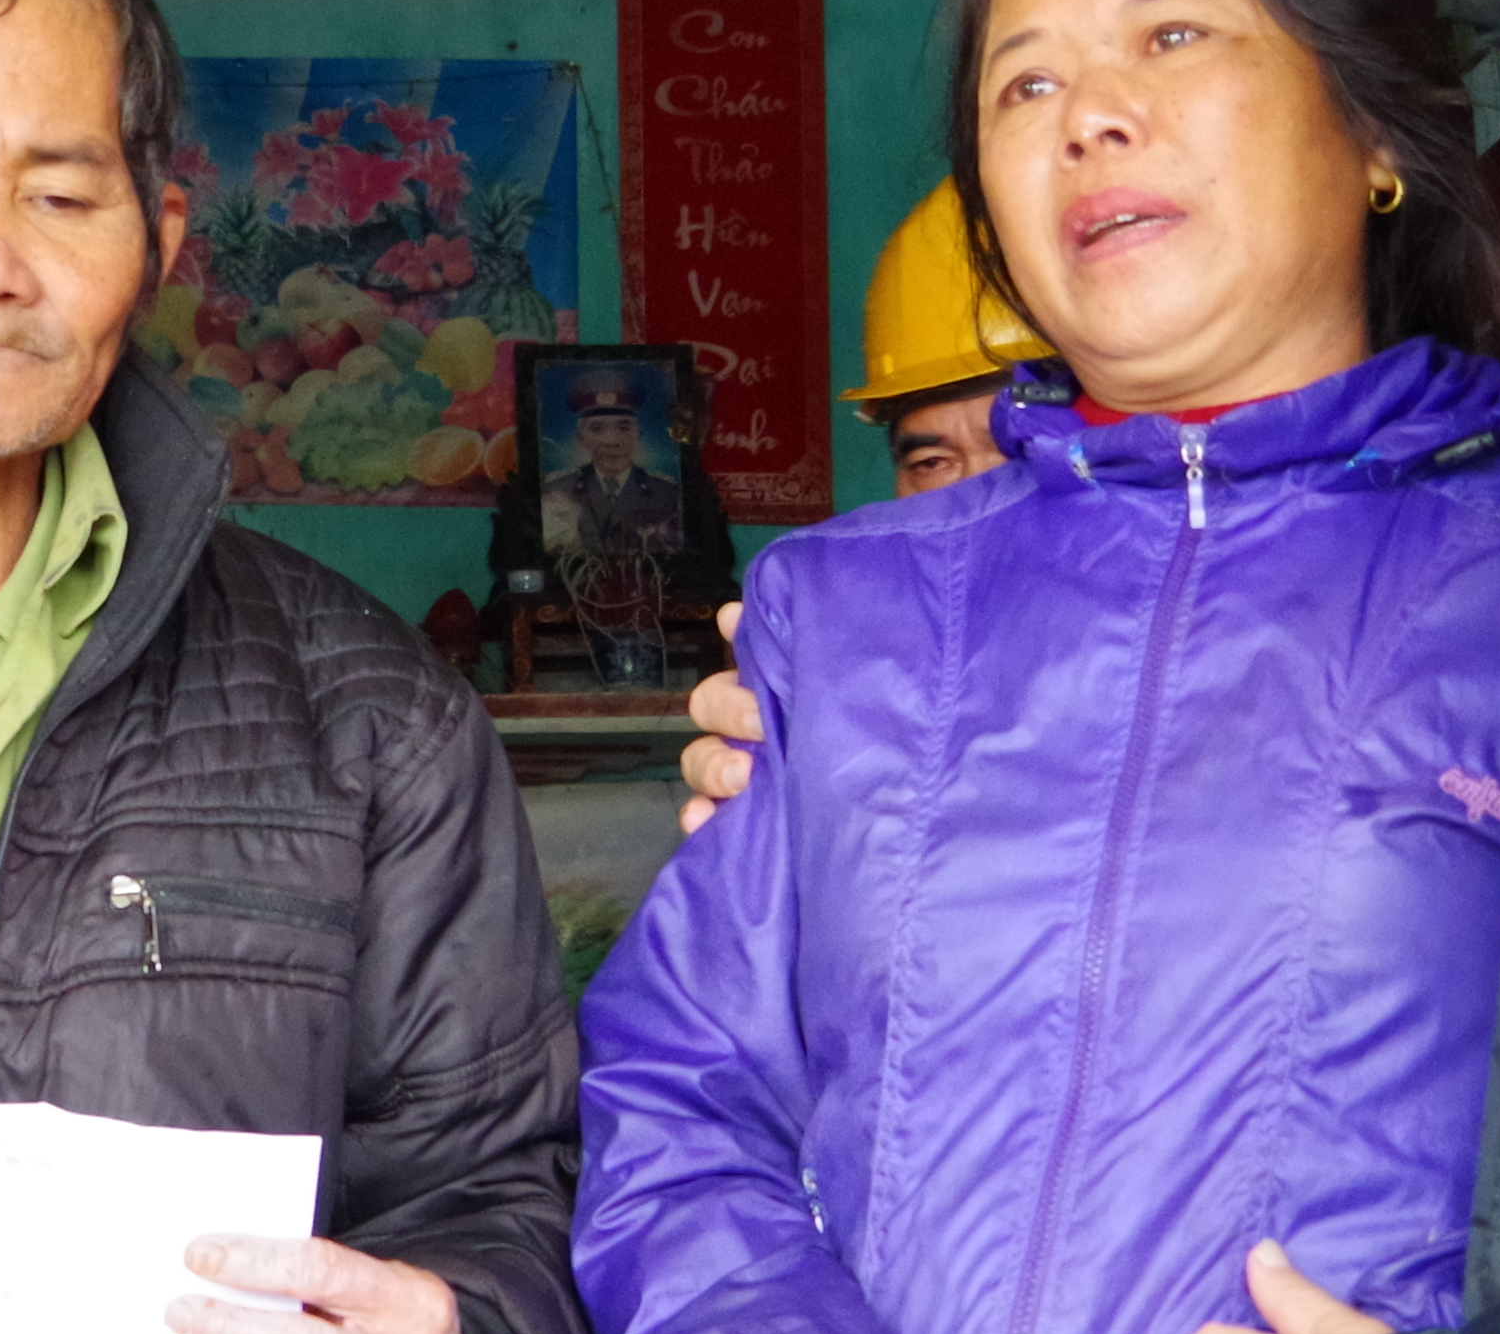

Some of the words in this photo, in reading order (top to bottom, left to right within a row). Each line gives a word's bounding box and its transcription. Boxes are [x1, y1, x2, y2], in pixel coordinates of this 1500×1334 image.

[668, 8, 771, 55] Con
[654, 73, 788, 120] Cháu
[674, 136, 774, 185] Thảo
[705, 407, 780, 455] inh
